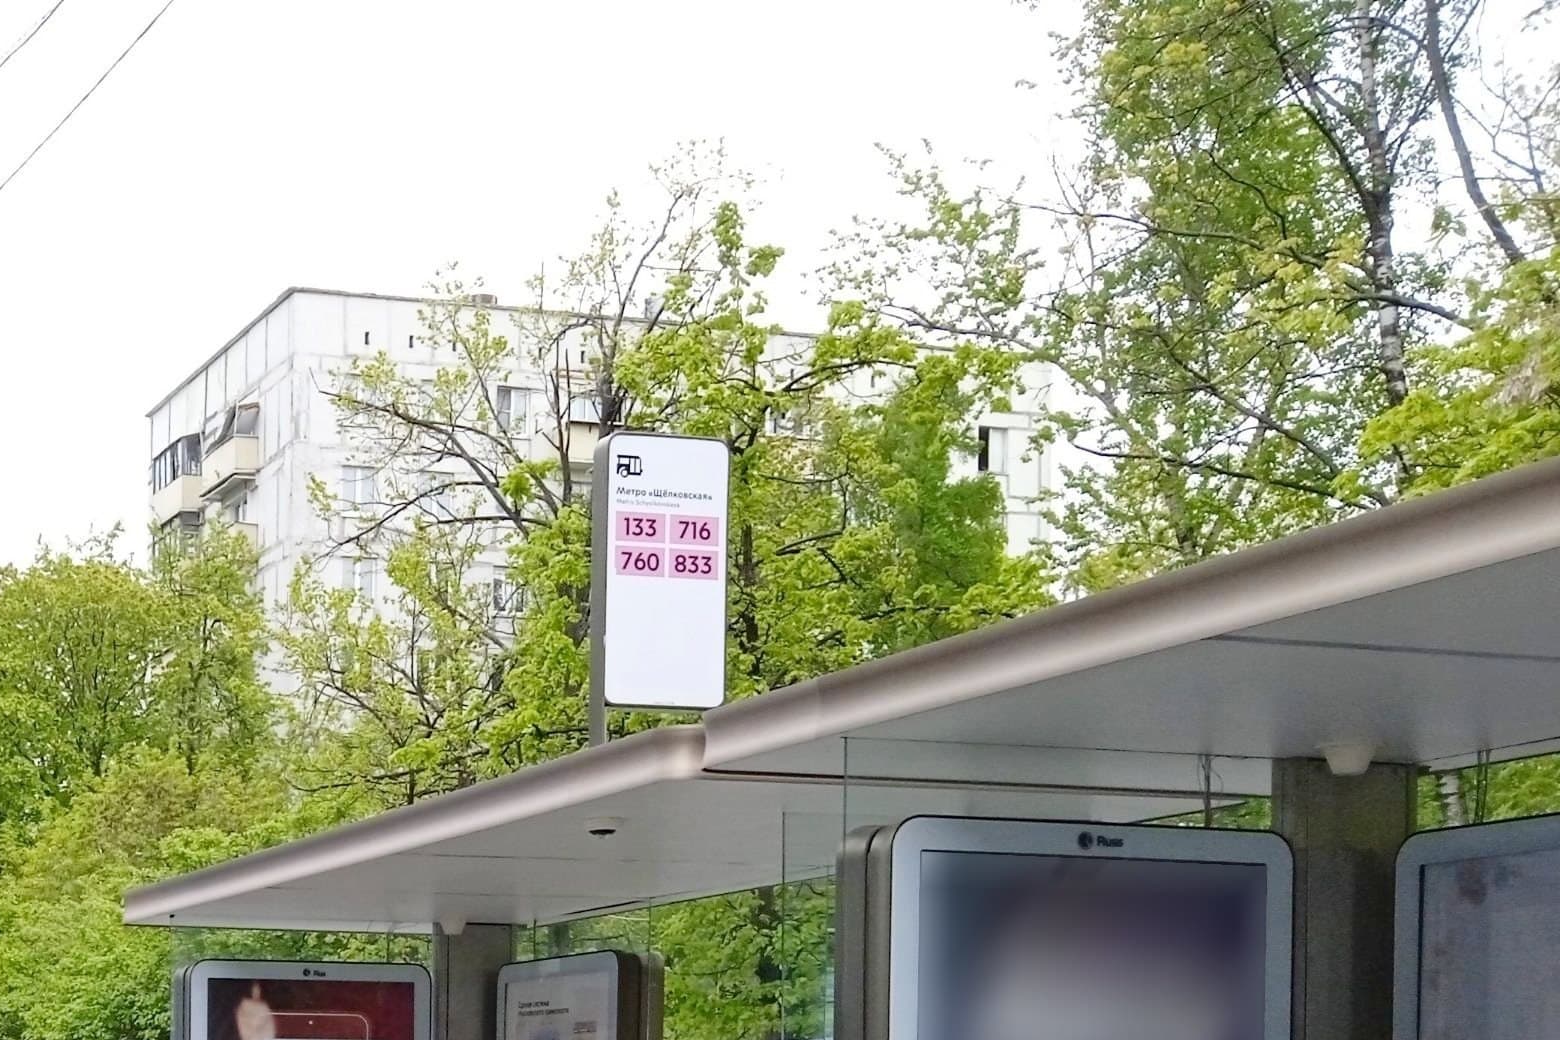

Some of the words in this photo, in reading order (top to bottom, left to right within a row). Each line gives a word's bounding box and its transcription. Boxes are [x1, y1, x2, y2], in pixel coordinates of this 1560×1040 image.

[624, 517, 657, 537] 133
[679, 521, 711, 541] 716
[621, 551, 660, 571] 760
[674, 555, 712, 574] 833
